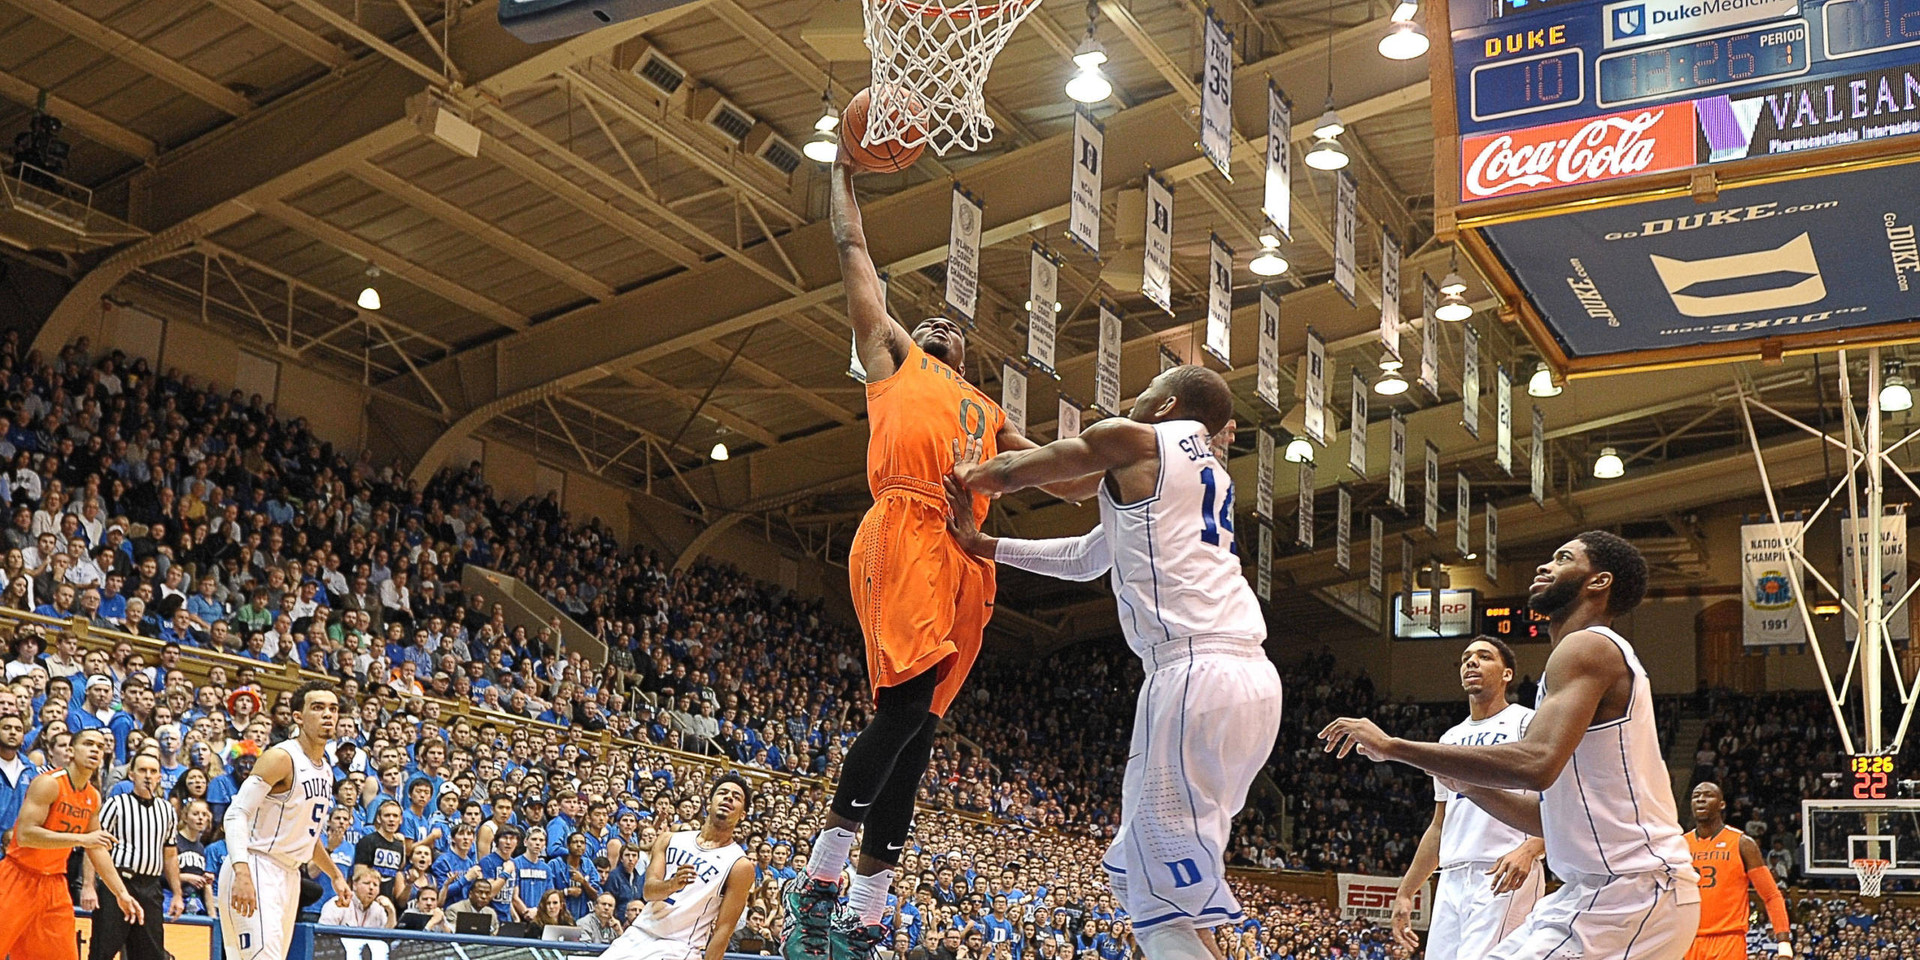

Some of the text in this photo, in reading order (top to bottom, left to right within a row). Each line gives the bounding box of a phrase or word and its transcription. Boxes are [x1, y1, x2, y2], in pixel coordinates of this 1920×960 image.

[1485, 25, 1566, 58] DUKE
[1759, 28, 1804, 47] PERIOD
[1209, 64, 1229, 105] 35
[1524, 58, 1563, 101] 10
[1466, 108, 1664, 195] Coca-Cola
[960, 398, 985, 440] 0
[1498, 620, 1511, 634] 10
[1762, 619, 1788, 630] 1991
[1852, 756, 1894, 773] 13:26
[1853, 772, 1888, 799] 22
[311, 803, 325, 837] 5
[666, 847, 719, 884] DUKE
[1163, 857, 1203, 889] D
